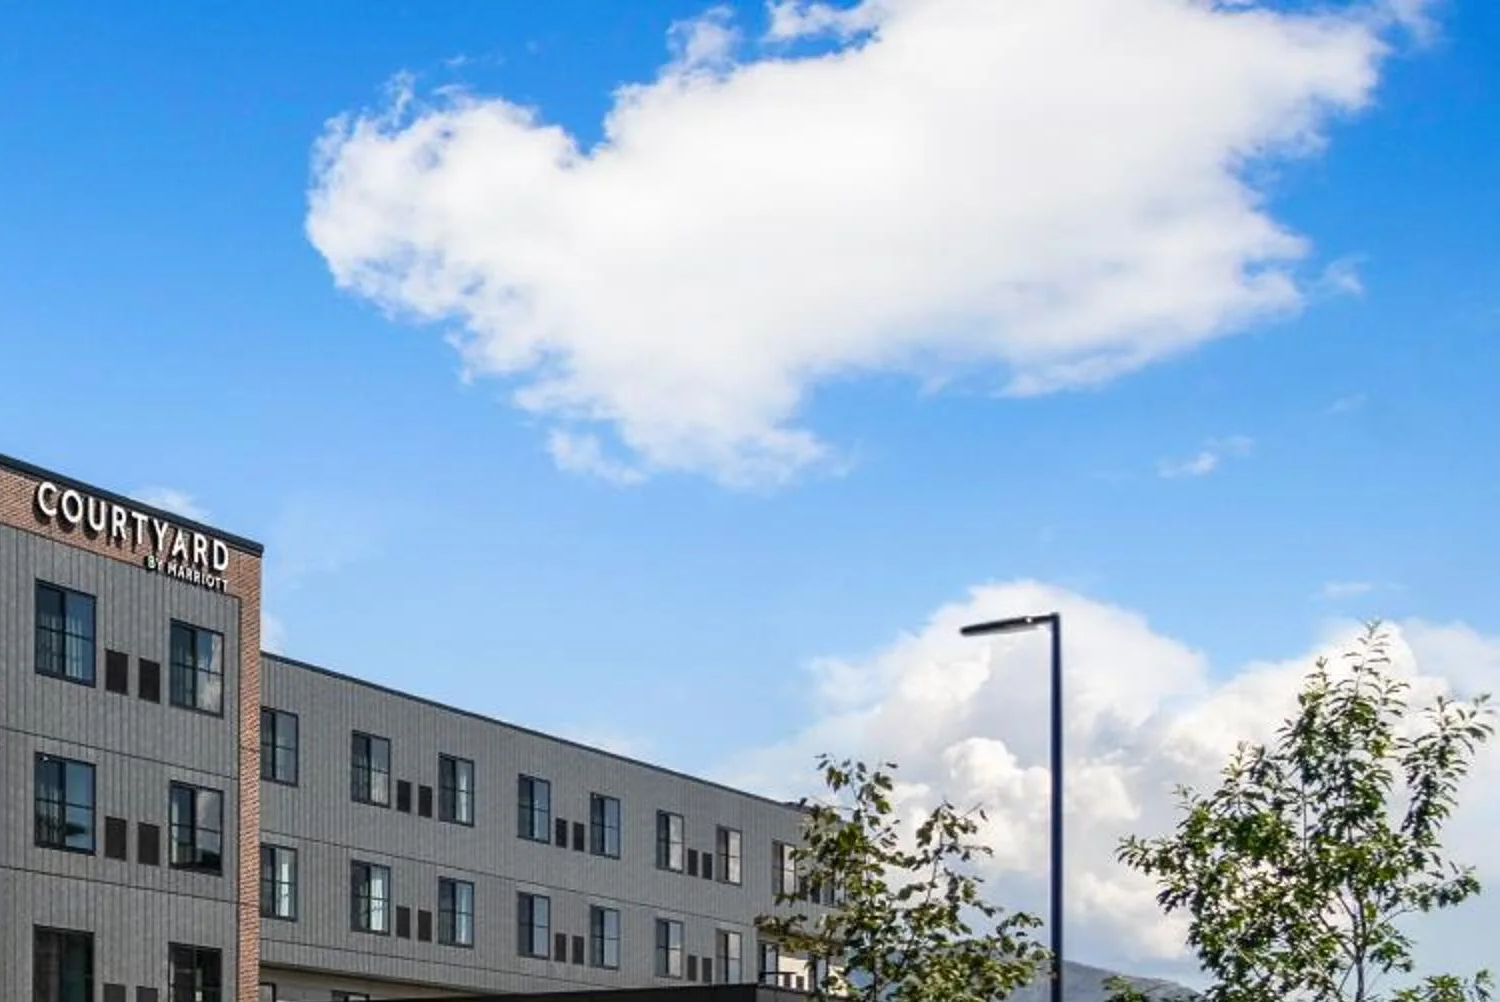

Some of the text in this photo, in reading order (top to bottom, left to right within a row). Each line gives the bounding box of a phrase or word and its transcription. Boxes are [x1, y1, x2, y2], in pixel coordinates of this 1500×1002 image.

[37, 481, 229, 571] COURTYARD
[147, 555, 229, 593] BY MARRIOTT
